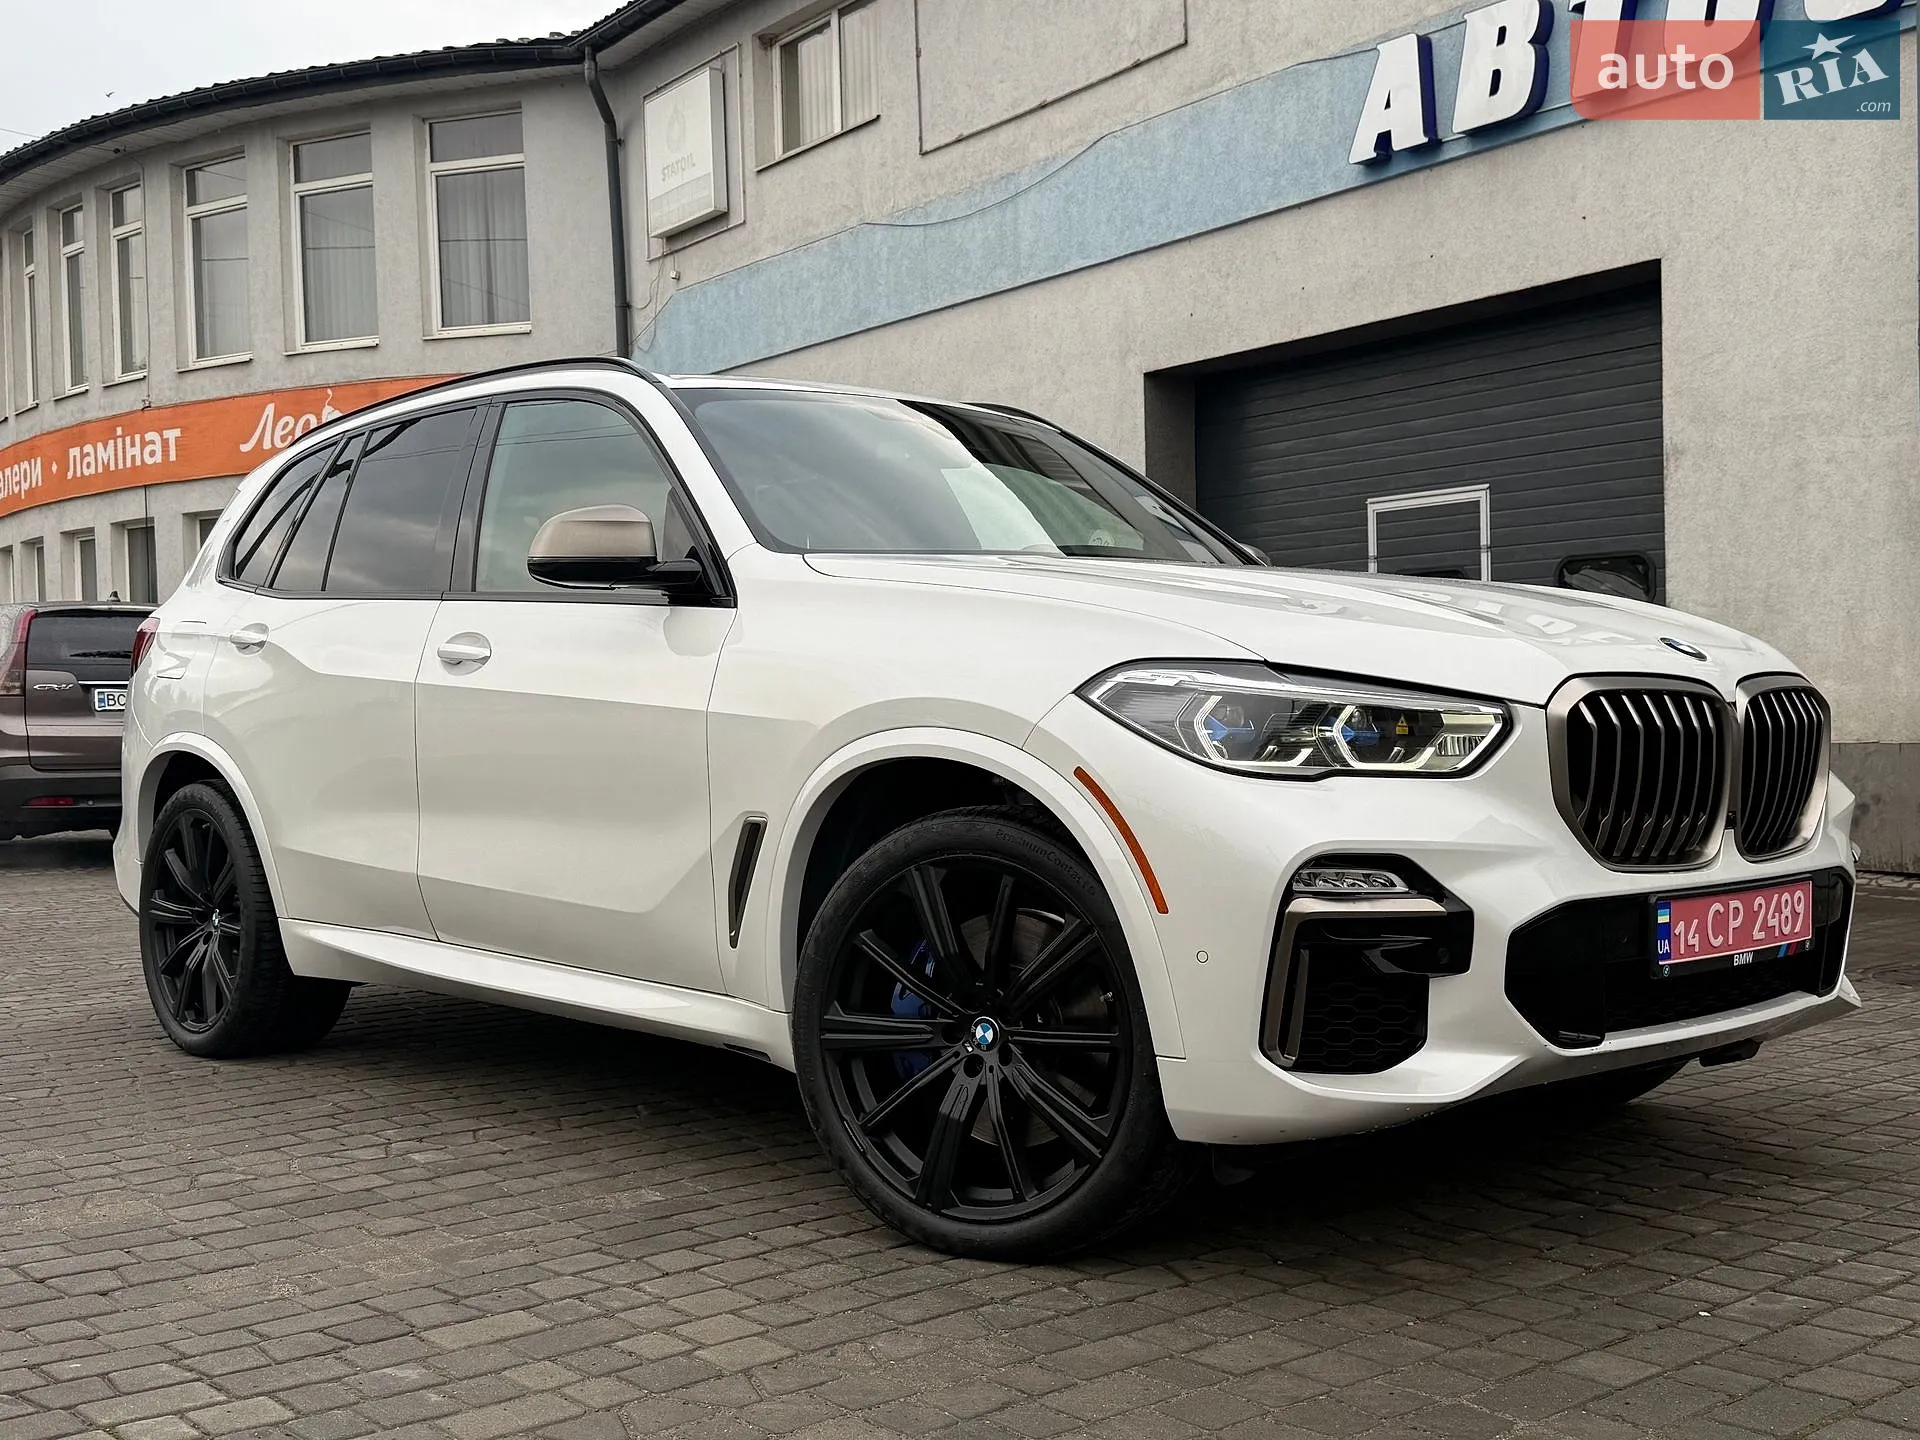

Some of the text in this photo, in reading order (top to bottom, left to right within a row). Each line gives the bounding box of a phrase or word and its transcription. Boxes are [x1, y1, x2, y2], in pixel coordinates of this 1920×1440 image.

[1349, 0, 1902, 166] АВТО
[661, 152, 696, 182] STATOIL
[67, 426, 182, 479] ламінат
[1673, 889, 1805, 955] 14 CP 2489
[1657, 938, 1670, 954] UA
[1733, 952, 1754, 966] BMW
